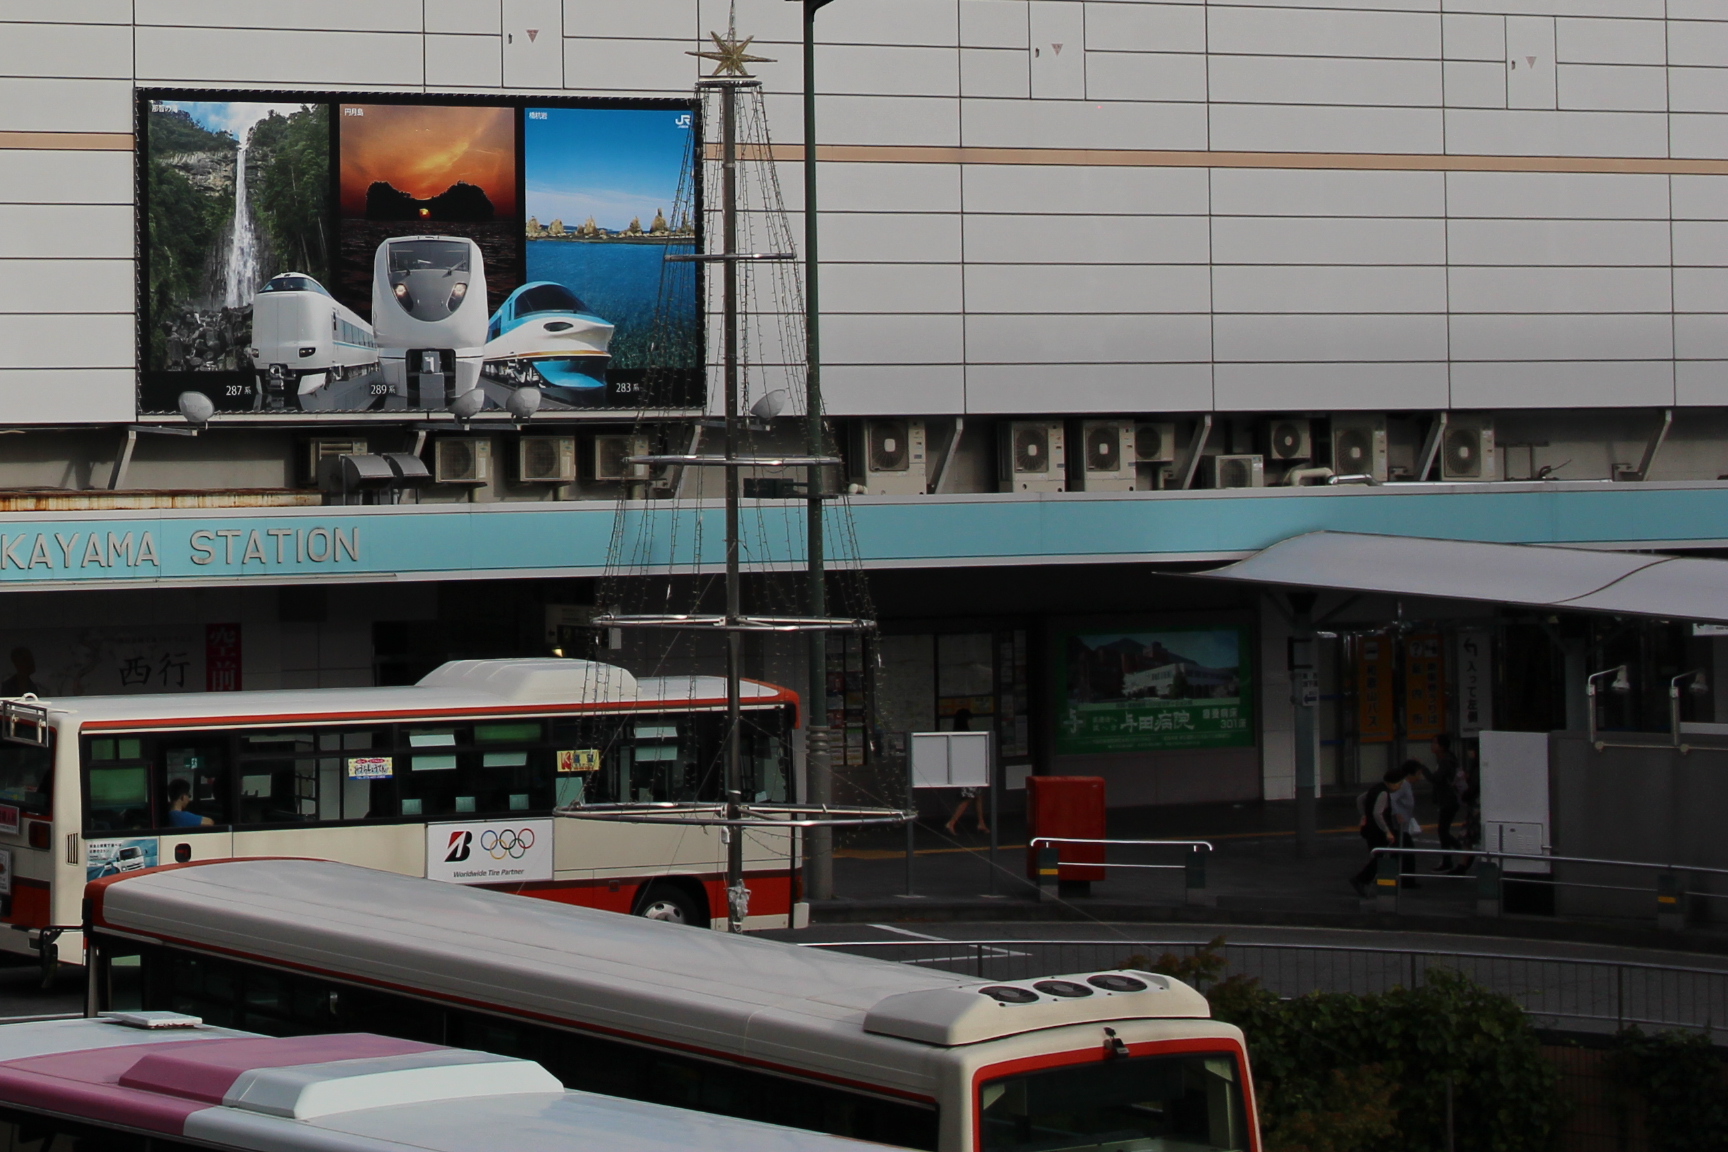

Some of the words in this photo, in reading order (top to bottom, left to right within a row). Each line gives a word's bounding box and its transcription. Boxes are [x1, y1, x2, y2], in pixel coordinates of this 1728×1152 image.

[189, 527, 360, 565] STATION
[119, 652, 191, 687] 西行
[453, 869, 487, 878] Worldwide
[501, 868, 525, 876] Partner
